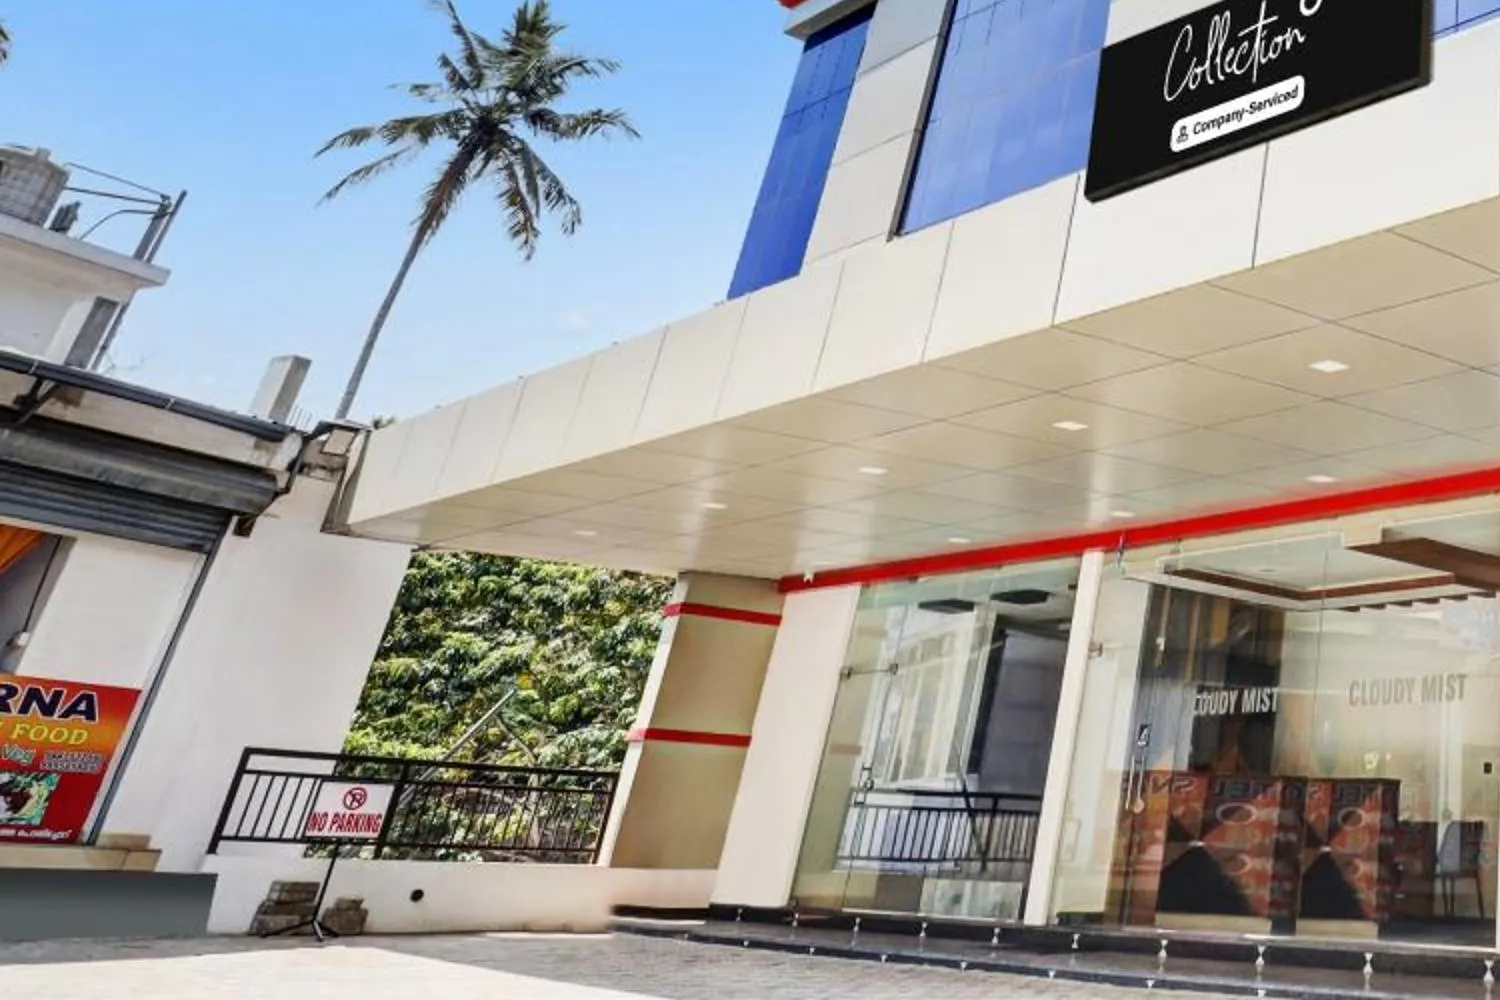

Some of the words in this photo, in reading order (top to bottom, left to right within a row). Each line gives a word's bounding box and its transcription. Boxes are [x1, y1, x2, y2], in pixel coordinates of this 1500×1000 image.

[1163, 0, 1306, 102] Collection
[1192, 83, 1299, 136] Company-Serviced
[1241, 685, 1279, 713] MIST
[1349, 677, 1416, 706] CLOUDY
[1420, 672, 1468, 703] MIST
[11, 723, 88, 745] FOOD
[306, 812, 328, 833] NO
[329, 811, 382, 833] PARKING
